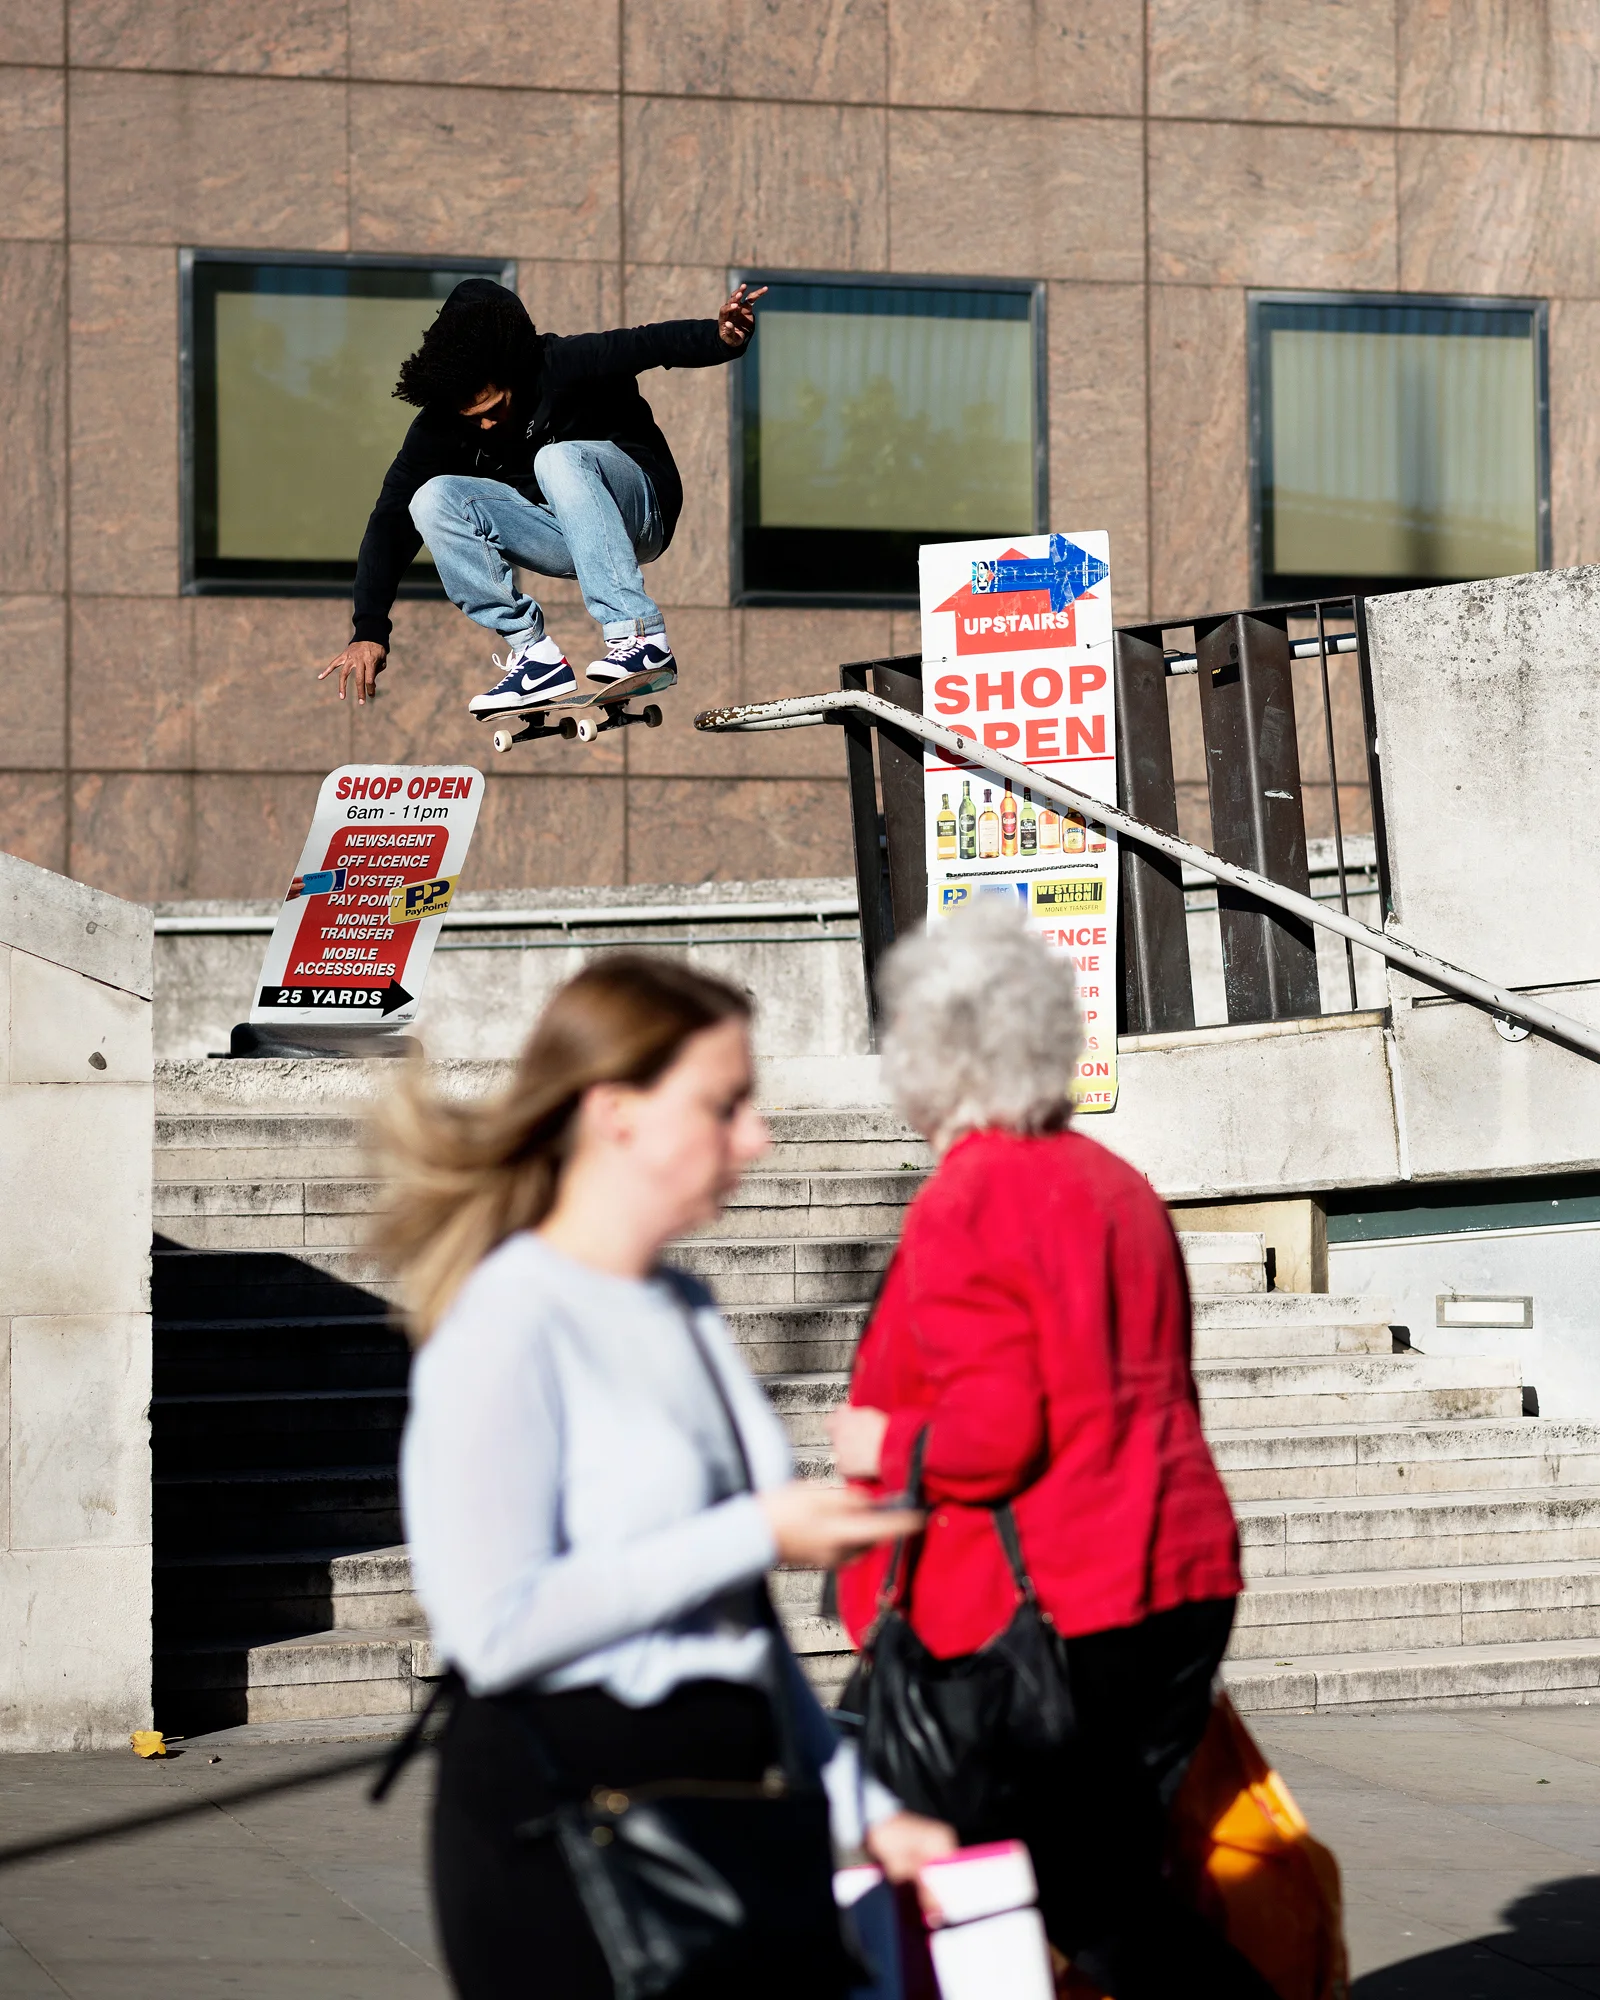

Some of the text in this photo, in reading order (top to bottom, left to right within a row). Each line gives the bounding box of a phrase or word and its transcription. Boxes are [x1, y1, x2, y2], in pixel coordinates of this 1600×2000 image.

[964, 612, 1069, 635] UPSTAIRS
[934, 664, 1107, 715] SHOP
[335, 776, 473, 800] SHOP OPEN
[347, 805, 384, 820] 6am
[402, 805, 449, 822] 11pm
[345, 833, 436, 848] NEWSAGENT
[337, 854, 430, 869] OFF LICENCE
[348, 874, 405, 888] OYSTER
[406, 880, 450, 909] PP
[943, 888, 967, 905] PP
[1037, 883, 1092, 895] WESTERN
[327, 893, 404, 907] PAY POINT
[1054, 891, 1092, 903] UNION
[405, 901, 448, 916] PayPoint
[1045, 905, 1068, 913] MONEY
[335, 913, 390, 926] MONEY
[320, 927, 395, 940] TRANSFER
[322, 947, 379, 960] MOBILE
[293, 962, 397, 976] ACCESSORIES
[277, 989, 383, 1006] 25 YARDS
